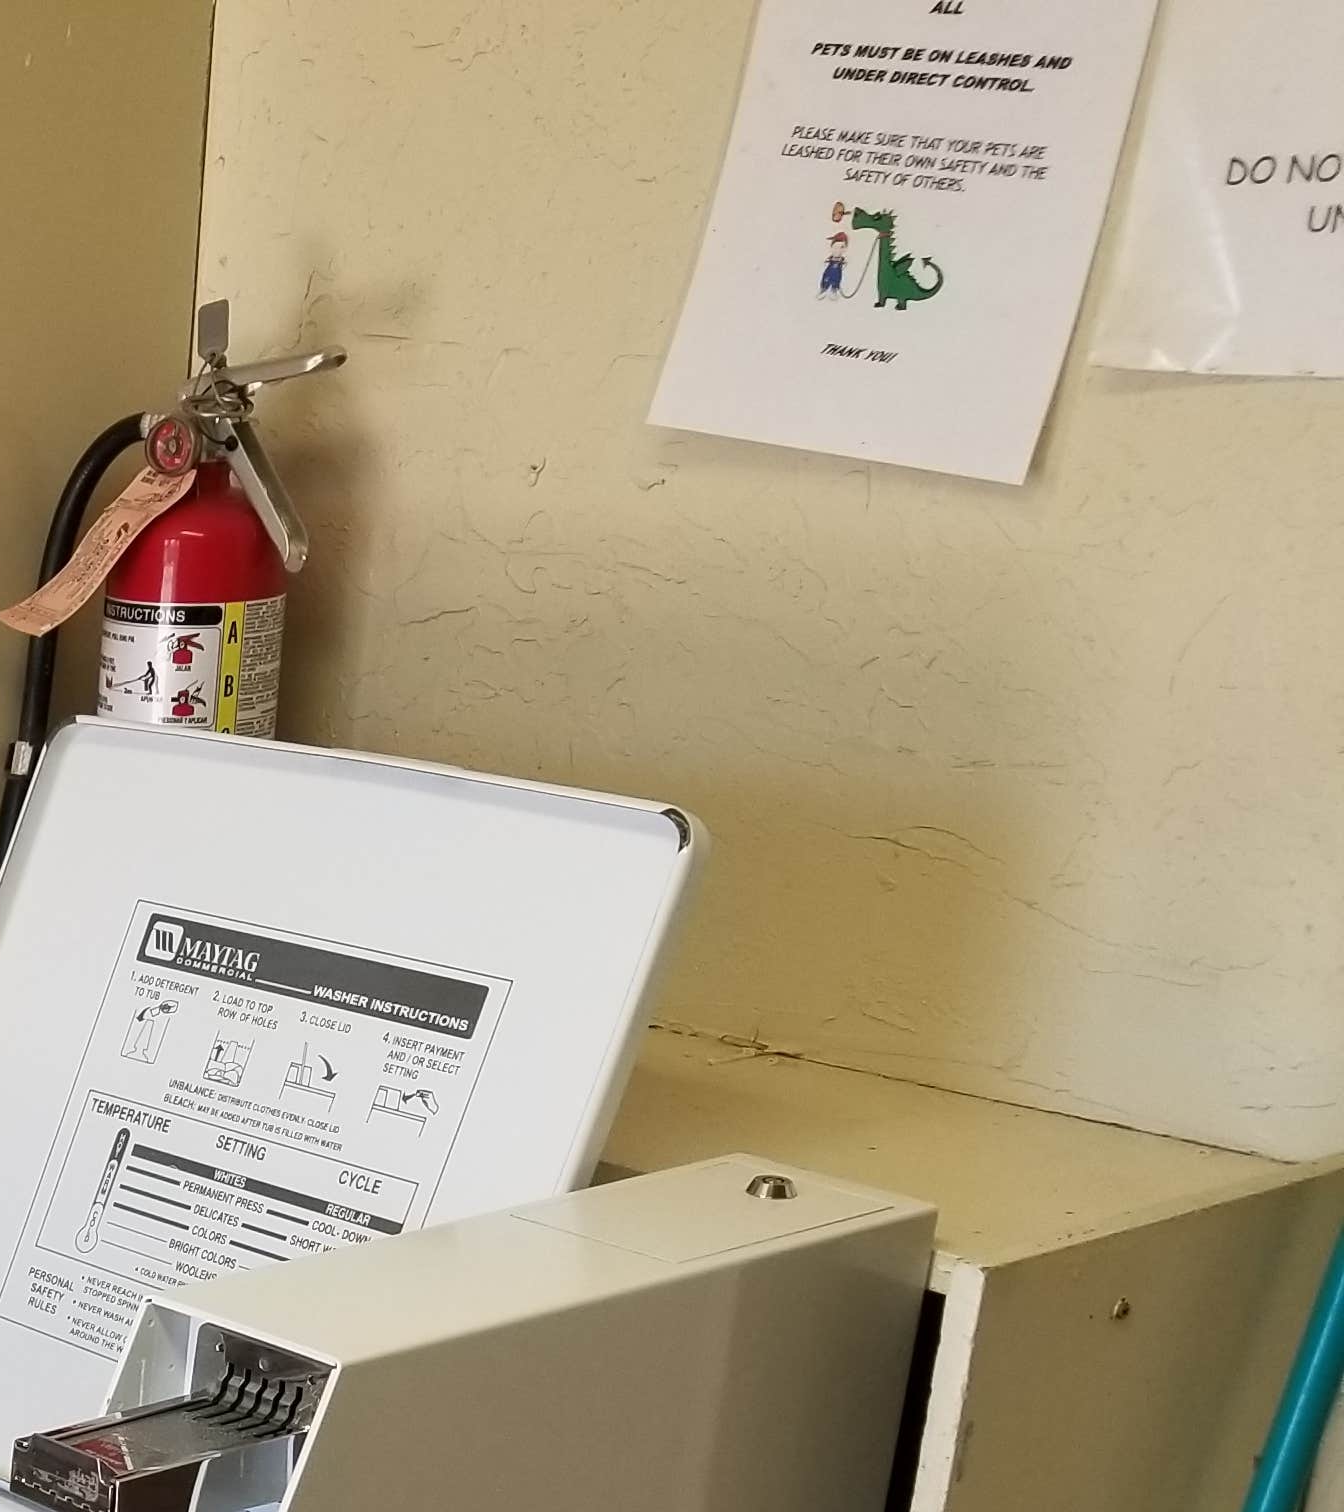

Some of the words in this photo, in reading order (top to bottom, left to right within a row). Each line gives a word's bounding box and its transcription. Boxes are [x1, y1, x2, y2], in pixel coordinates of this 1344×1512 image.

[929, 0, 965, 15] ALL
[811, 42, 852, 57] PETS
[853, 45, 901, 60] MUST
[902, 48, 925, 62] BE
[927, 49, 953, 64] ON
[955, 51, 1032, 69] LEASHES
[1035, 55, 1073, 70] AND
[833, 66, 885, 83] UNDER
[888, 71, 950, 88] DIRECT
[791, 125, 837, 142] PLEASE
[837, 128, 874, 146] MAKE
[875, 132, 907, 149] SURE
[911, 134, 945, 151] THAT
[946, 137, 983, 155] YOUR
[983, 141, 1017, 159] PETS
[1018, 145, 1049, 160] ARE
[781, 143, 834, 160] LEASHED
[837, 148, 863, 163] FOR
[866, 150, 902, 167] THEIR
[904, 153, 939, 170] OWN
[939, 157, 990, 175] SAFETY
[989, 162, 1021, 178] AND
[1021, 165, 1049, 181] THE
[1225, 156, 1277, 186] DO
[843, 167, 892, 185] SAFETY
[892, 172, 912, 187] OF
[912, 174, 967, 193] OTHERS.
[820, 343, 868, 359] THANK
[105, 605, 187, 624] NSTRUCTIONS
[227, 621, 239, 645] A
[223, 674, 234, 698] B
[180, 937, 261, 973] MAYTAG
[176, 957, 254, 983] COMMERCIAL
[130, 970, 138, 982] 1.
[138, 972, 155, 986] ADD
[155, 976, 200, 998] DETERGENT
[135, 985, 145, 997] TO
[146, 988, 161, 1001] TUB
[212, 990, 220, 1002] 2.
[222, 994, 245, 1009] LOAD
[245, 999, 257, 1011] TO
[257, 1002, 274, 1015] TOP
[313, 984, 369, 1009] WASHER
[369, 998, 470, 1032] INSTRUCTIONS
[217, 1006, 237, 1021] ROW
[239, 1012, 253, 1025] OF
[252, 1015, 279, 1030] HOLES
[299, 1011, 309, 1024] 3.
[309, 1014, 338, 1031] CLOSE
[338, 1021, 353, 1034] LID
[382, 1031, 392, 1045] 4.
[392, 1035, 424, 1053] INSERT
[424, 1042, 465, 1062] PAYMENT
[382, 1062, 420, 1080] SETTING
[387, 1049, 407, 1062] AND
[411, 1054, 426, 1068] OR
[425, 1058, 462, 1076] SELECT
[90, 1097, 172, 1134] TEMPERATURE
[217, 1093, 253, 1111] DISTRIBUTE
[252, 1102, 282, 1120] CLOTHES
[307, 1118, 329, 1131] CLOSE
[328, 1124, 341, 1135] LID
[215, 1134, 268, 1162] SETTING
[338, 1169, 383, 1196] CYCLE
[182, 1180, 237, 1206] PERMANENT
[236, 1196, 266, 1215] PRESS
[213, 1167, 248, 1189] WHITES
[325, 1203, 372, 1227] REGULAR
[191, 1225, 228, 1246] COLORS
[192, 1203, 241, 1228] DELICATES
[289, 1234, 322, 1254] SHORT
[168, 1238, 201, 1258] BRIGHT
[200, 1248, 238, 1271] COLORS
[28, 1266, 76, 1293] PERSONAL
[30, 1282, 65, 1302] SAFETY
[87, 1275, 112, 1291] NEVER
[112, 1284, 138, 1300] REACH
[27, 1296, 58, 1316] RULES
[83, 1286, 117, 1307] STOPPED
[78, 1300, 103, 1316] NEVER
[103, 1310, 125, 1324] WASH
[69, 1327, 100, 1345] AROUND
[100, 1338, 116, 1350] THE
[72, 1315, 96, 1331] NEVER
[95, 1325, 123, 1341] ALLOW
